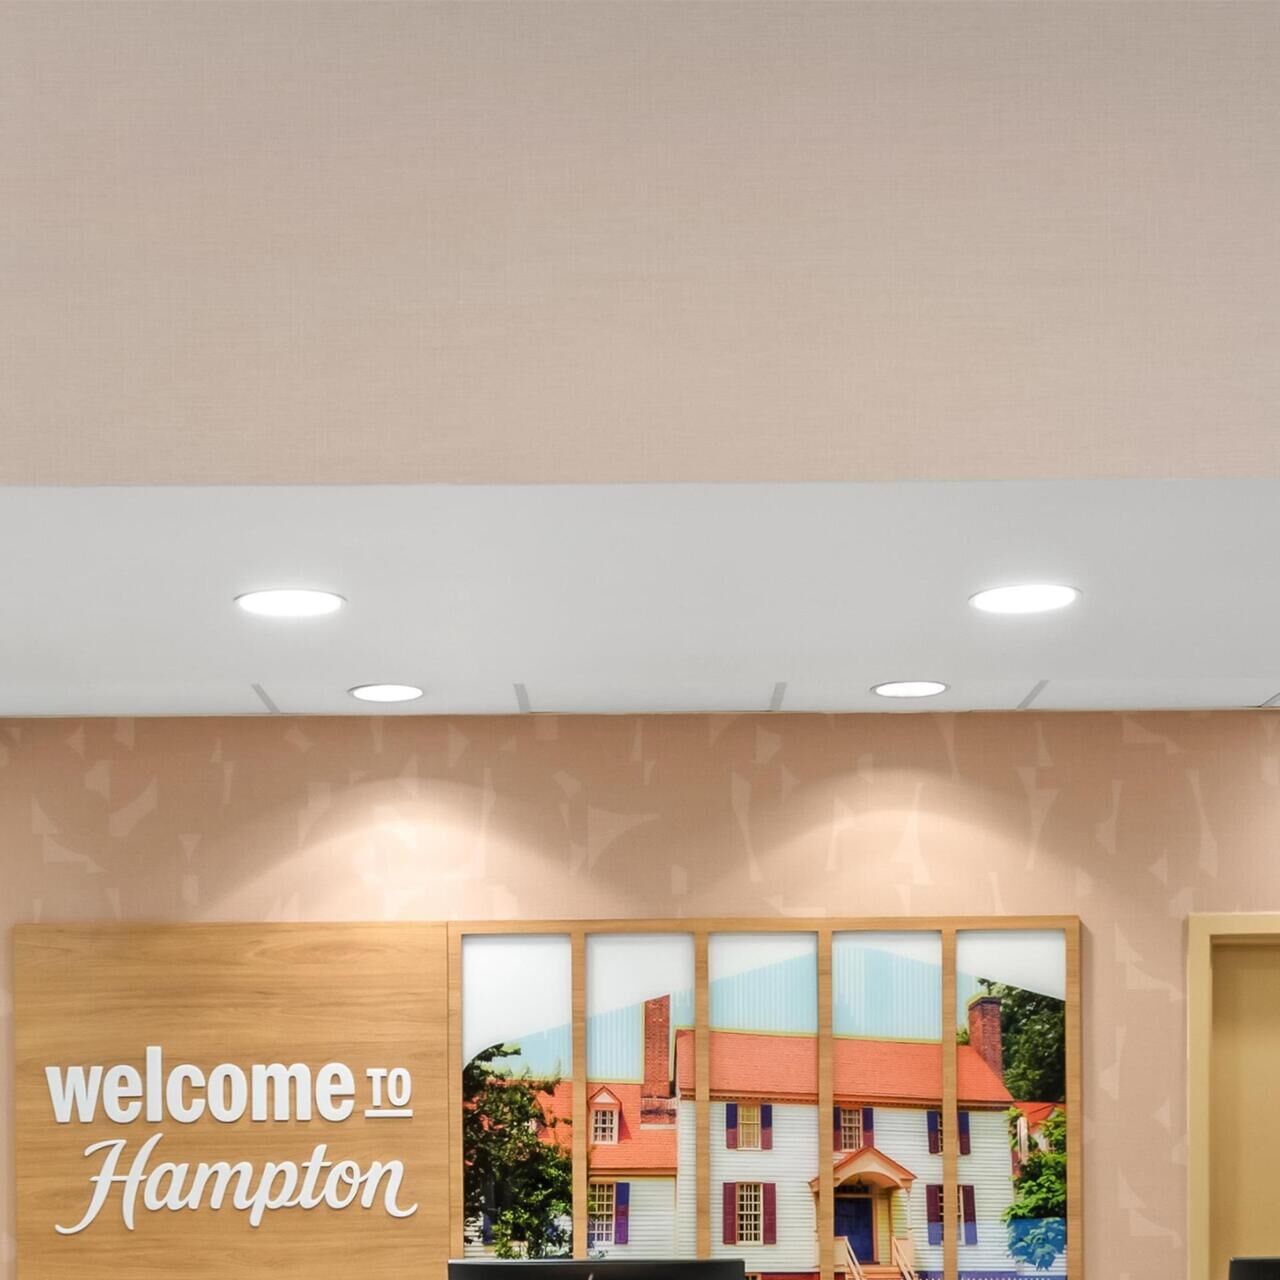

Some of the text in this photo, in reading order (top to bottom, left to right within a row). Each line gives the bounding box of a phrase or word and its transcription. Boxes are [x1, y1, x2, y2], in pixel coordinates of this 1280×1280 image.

[44, 1045, 412, 1123] welcome TO
[55, 1132, 418, 1235] Hampton
